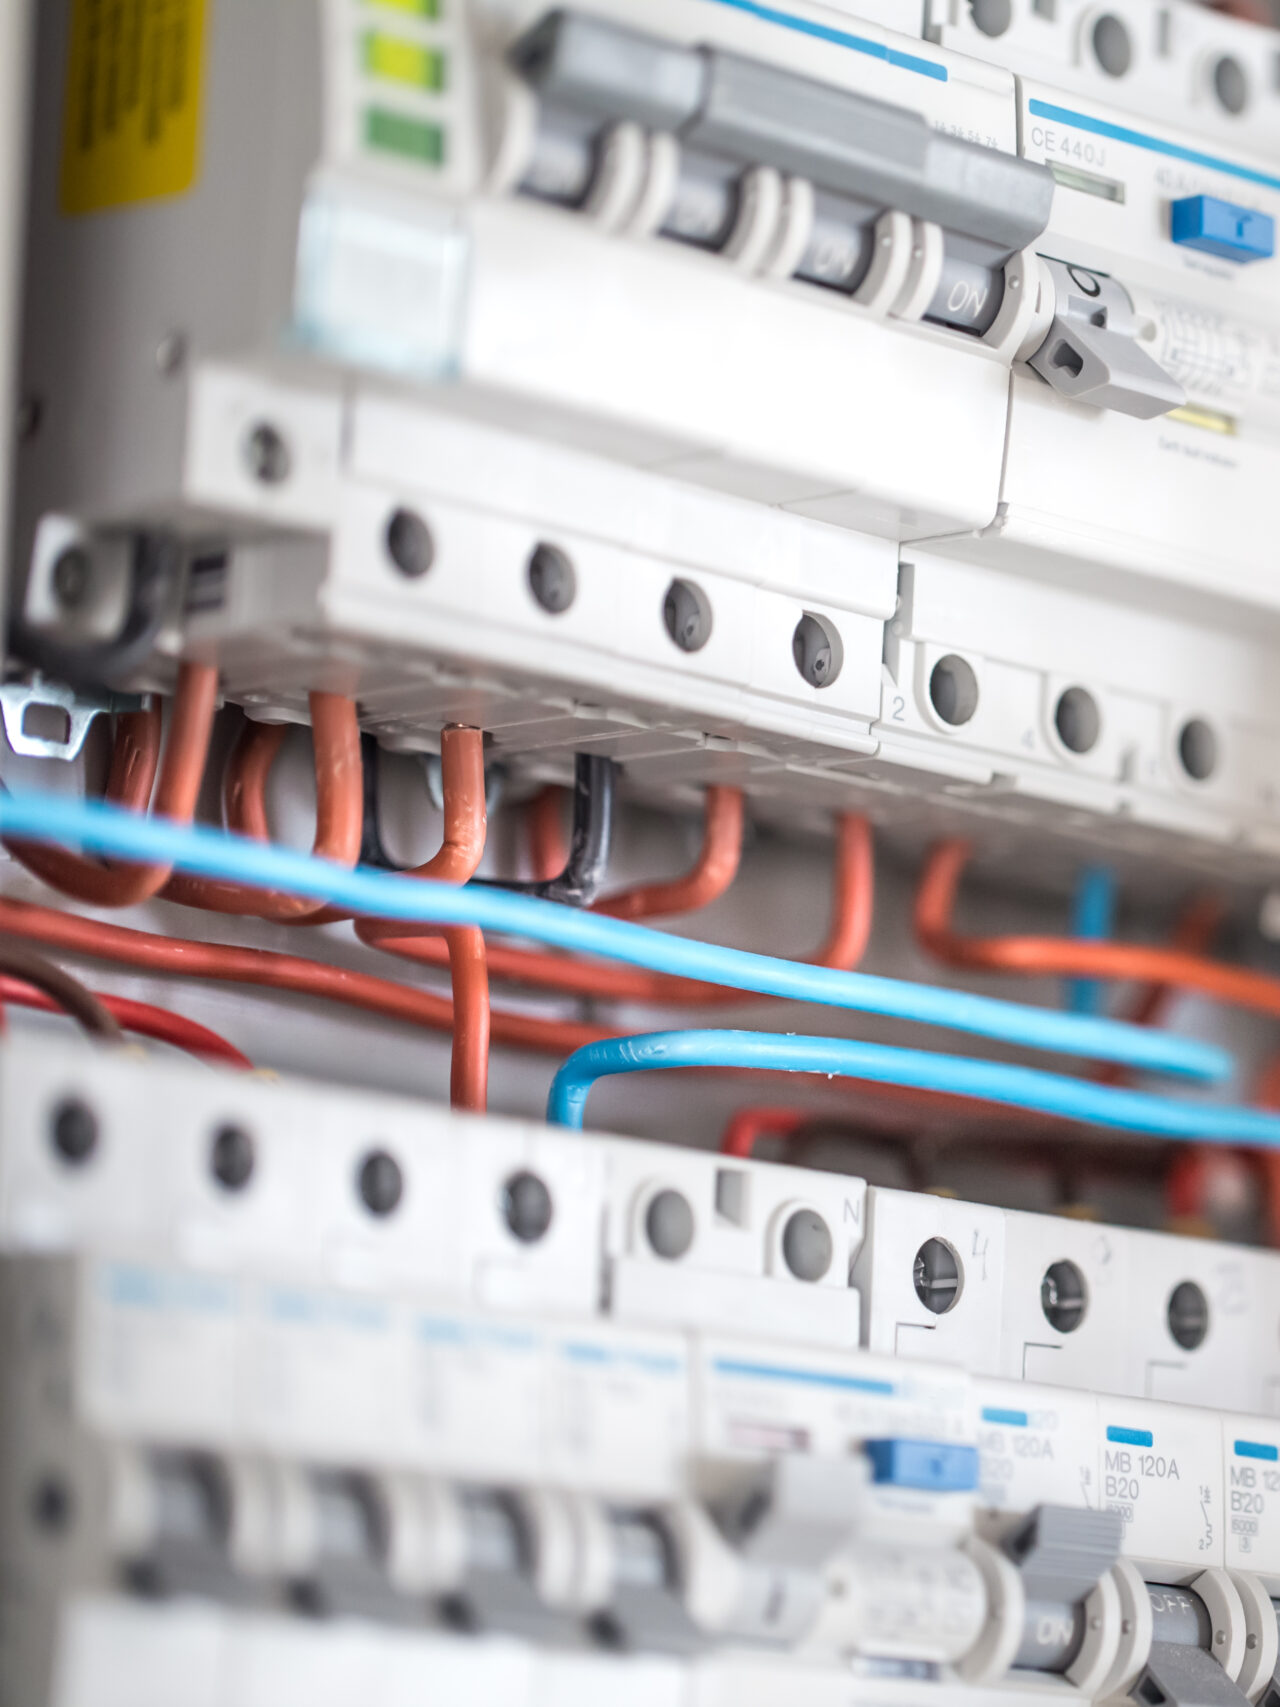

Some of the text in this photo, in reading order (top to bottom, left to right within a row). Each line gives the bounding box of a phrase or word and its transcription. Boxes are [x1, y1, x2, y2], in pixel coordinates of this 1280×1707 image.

[1031, 126, 1056, 152] CE
[947, 280, 988, 318] ON
[892, 696, 905, 721] 2
[843, 1198, 860, 1224] N
[1105, 1449, 1180, 1480] MB 120A
[1230, 1464, 1256, 1488] MB
[1105, 1475, 1139, 1500] B20
[1230, 1490, 1265, 1515] B20
[1150, 1591, 1193, 1615] OFF
[1037, 1615, 1074, 1645] ON
